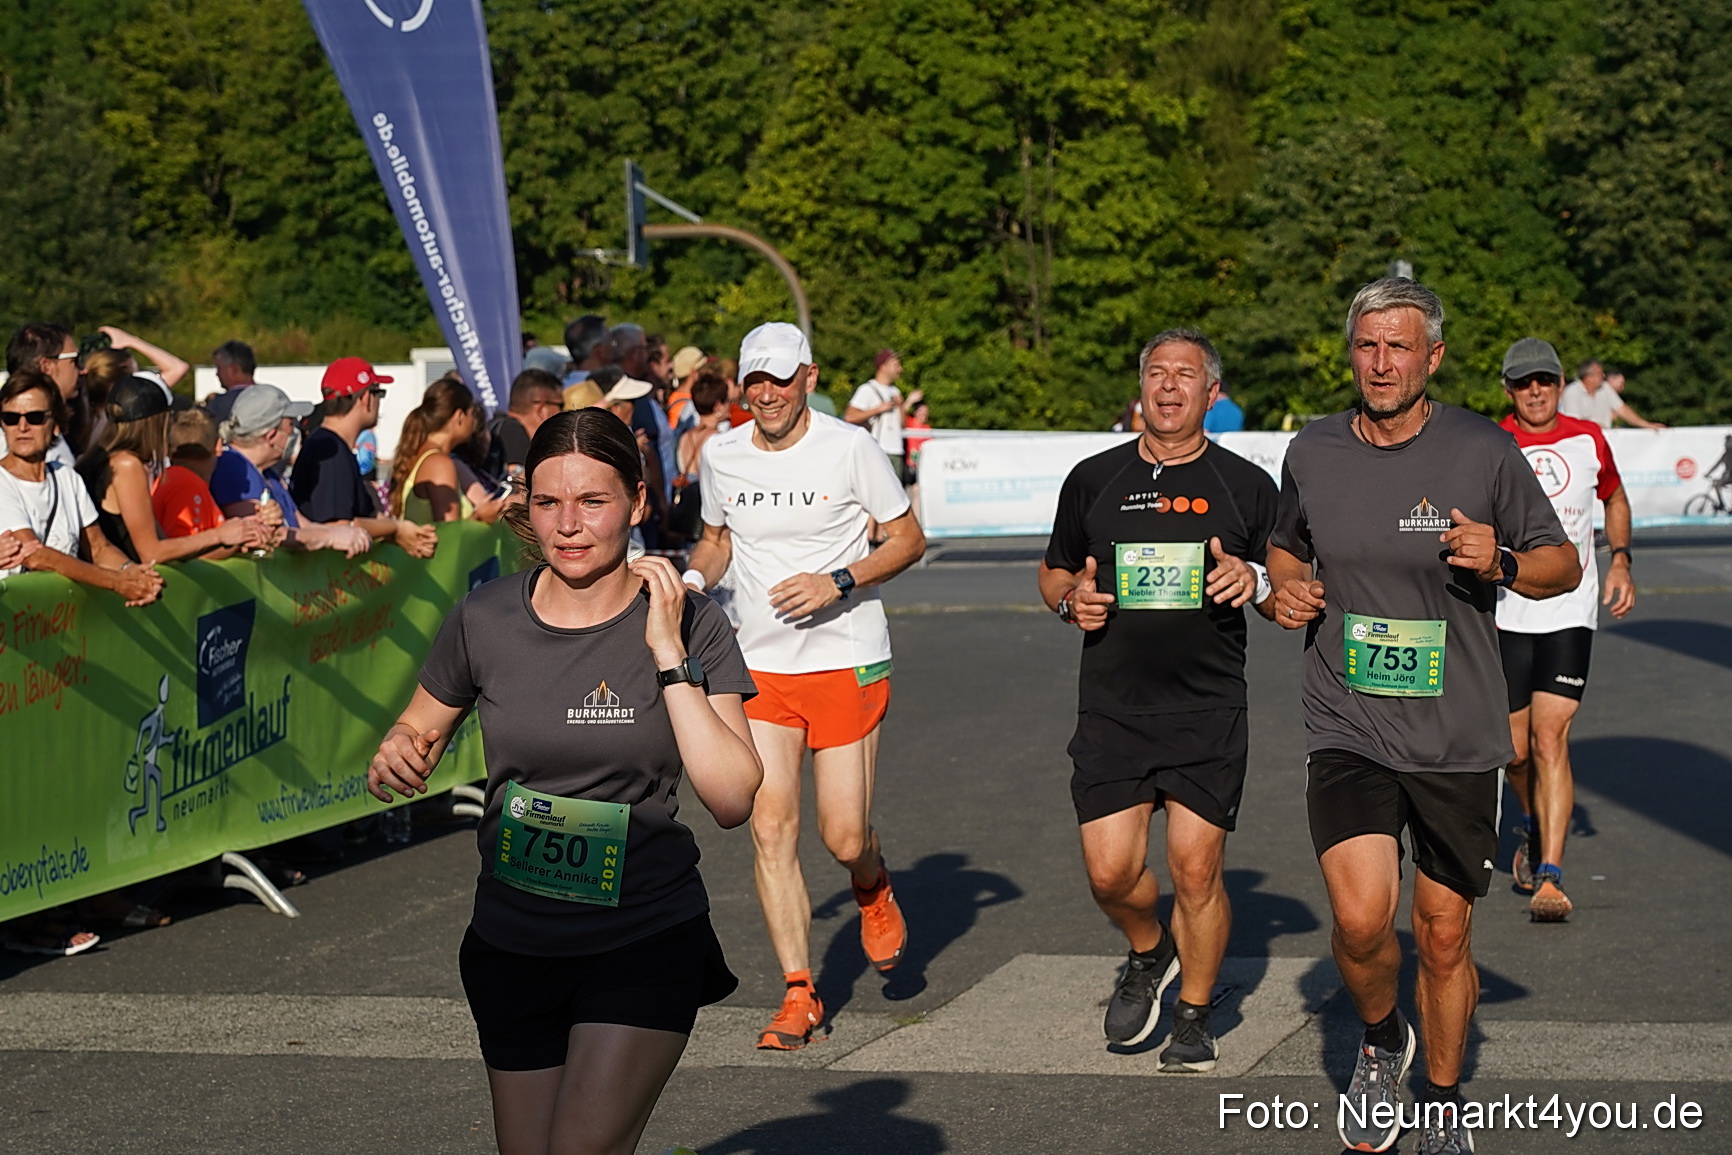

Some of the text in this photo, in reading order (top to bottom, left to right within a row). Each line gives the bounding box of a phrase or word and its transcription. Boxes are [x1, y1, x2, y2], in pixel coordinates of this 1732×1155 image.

[736, 491, 815, 506] APTIV
[1128, 491, 1159, 501] APTIV
[1398, 518, 1451, 528] BURKHARDT
[1121, 572, 1129, 597] RUN
[1136, 565, 1182, 587] 232
[1190, 569, 1200, 600] 2022
[1128, 588, 1191, 597] Niebler Thomas
[1367, 631, 1400, 639] Firmenlauf
[208, 637, 244, 668] Fischer
[1349, 648, 1357, 675] RUN
[1366, 643, 1418, 672] 753
[1366, 670, 1416, 685] Heim Jörg
[1429, 650, 1440, 686] 2022
[567, 707, 635, 719] BURKHARDT
[172, 674, 291, 793] firmenlauf
[173, 773, 229, 820] neumarkt
[525, 809, 567, 824] Firmenlauf
[539, 820, 565, 828] neumarkt
[501, 828, 513, 863] RUN
[522, 825, 589, 869] 750
[0, 836, 90, 899] oberpfalz.de
[509, 855, 600, 886] Sellerer Annika
[601, 844, 618, 892] 2022
